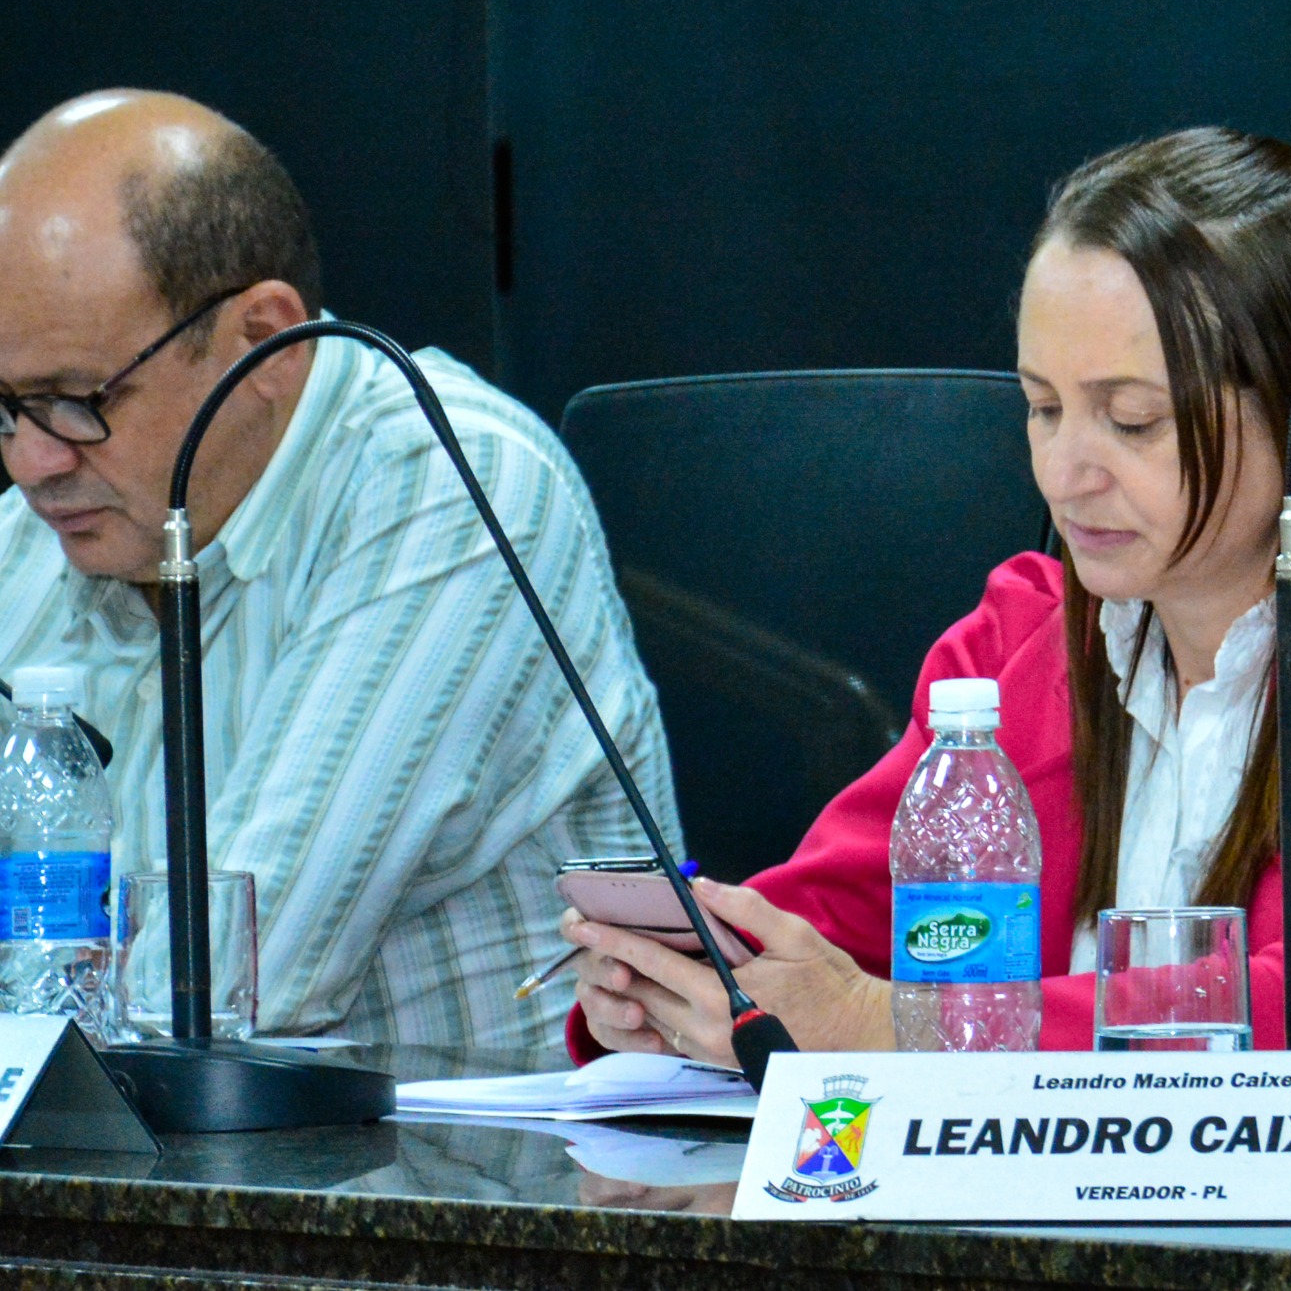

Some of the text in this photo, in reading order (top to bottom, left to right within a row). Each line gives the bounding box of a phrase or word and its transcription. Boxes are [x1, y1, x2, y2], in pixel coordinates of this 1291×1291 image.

[929, 921, 977, 937] Serra
[917, 932, 970, 952] Negra
[1033, 1073, 1127, 1090] Leandro
[1133, 1072, 1224, 1089] Maximo
[902, 1116, 1173, 1156] LEANDRO
[1075, 1185, 1186, 1200] VEREADOR
[1202, 1185, 1228, 1199] PL
